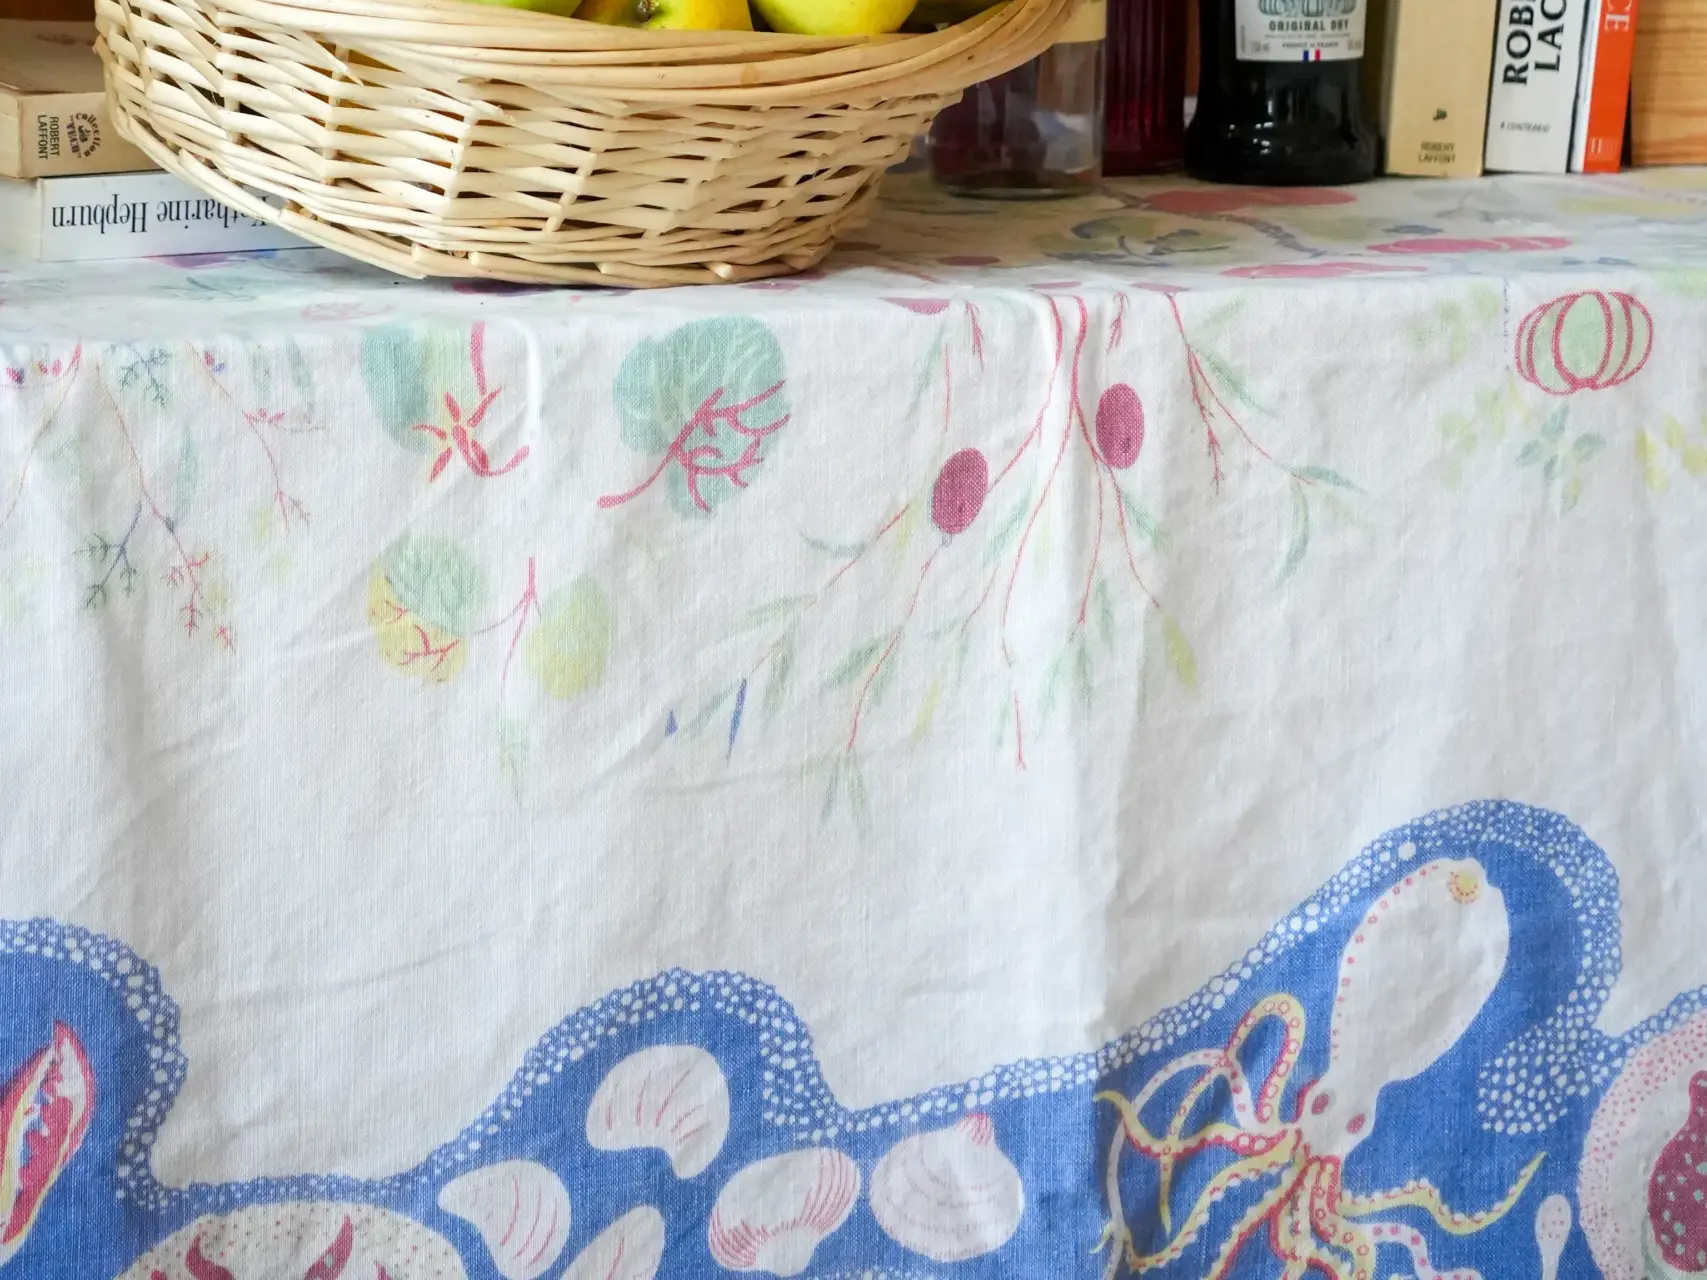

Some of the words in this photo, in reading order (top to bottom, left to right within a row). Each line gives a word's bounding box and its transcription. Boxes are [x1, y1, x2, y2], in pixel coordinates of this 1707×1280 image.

[1269, 20, 1326, 32] ORIGINAL
[37, 114, 49, 160] LAFFONT
[49, 115, 60, 157] ROBERT
[52, 193, 150, 234] Hepburn
